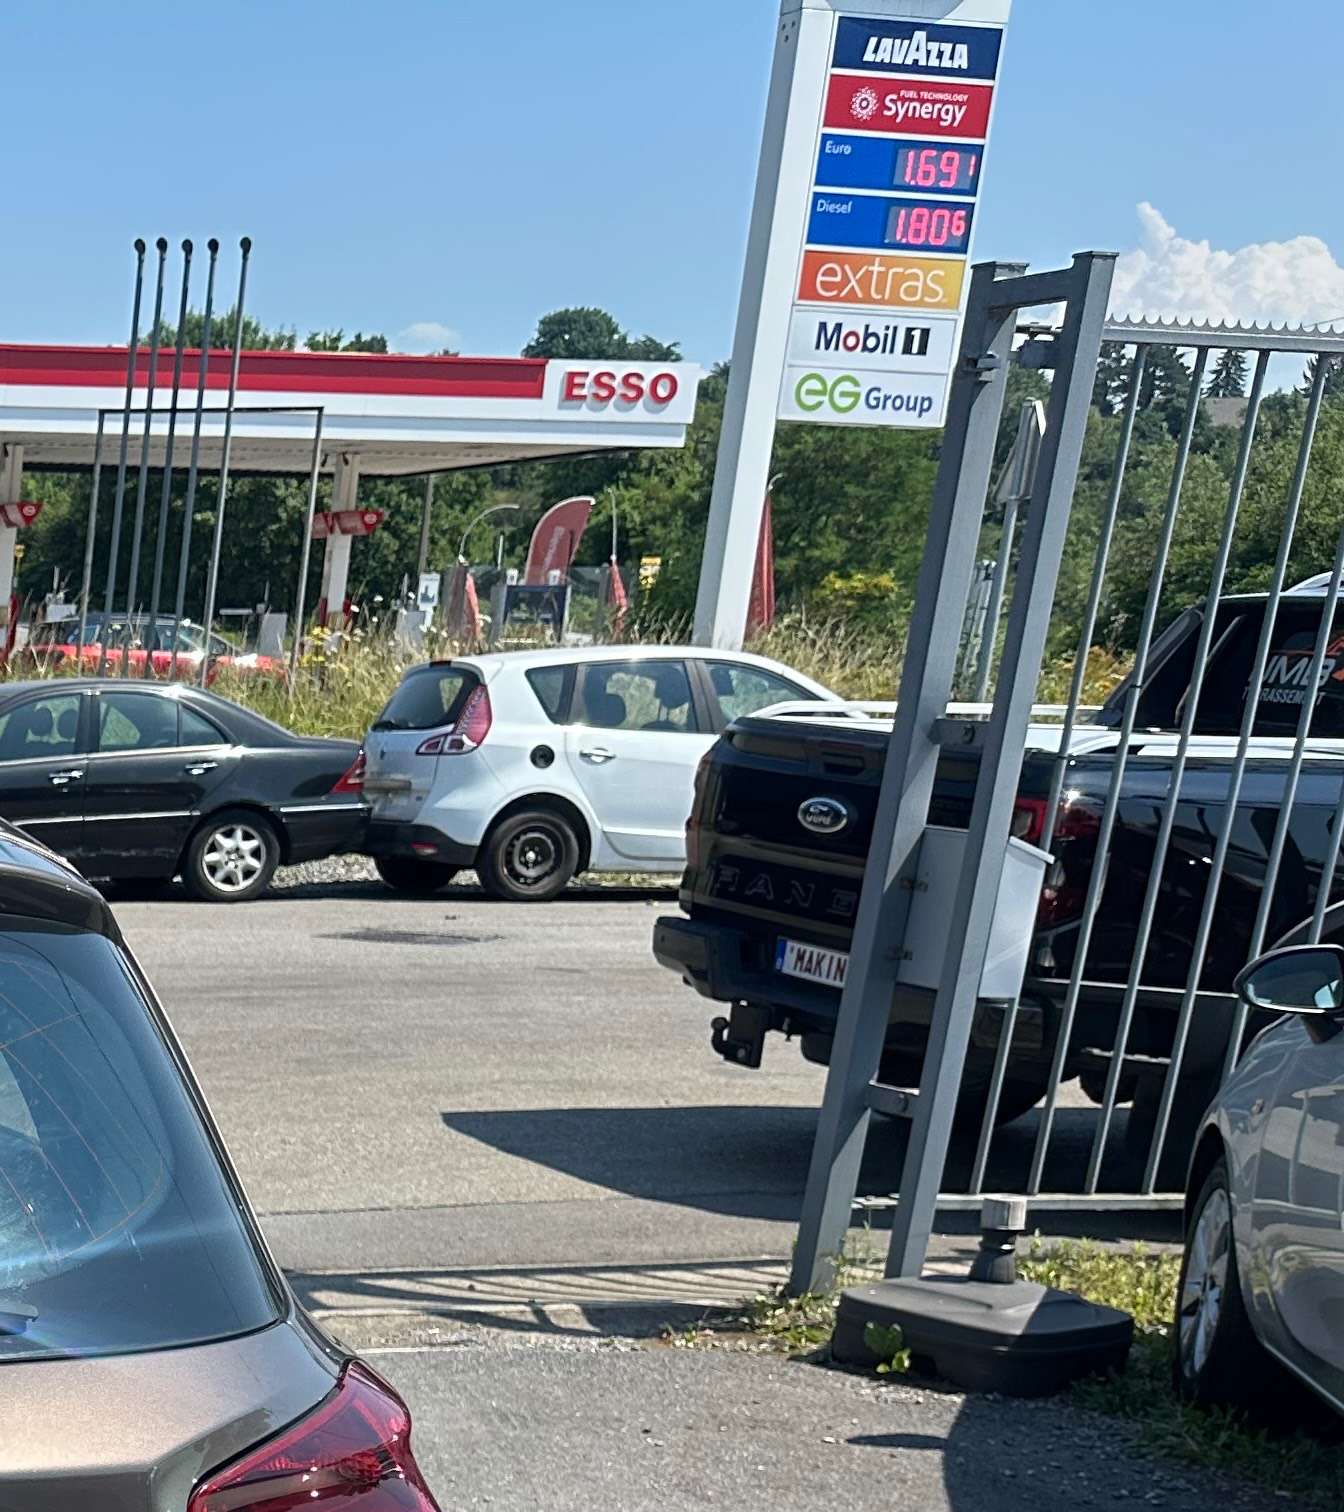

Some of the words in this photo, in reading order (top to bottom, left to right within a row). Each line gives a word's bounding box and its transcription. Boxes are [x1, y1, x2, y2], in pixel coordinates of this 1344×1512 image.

[862, 30, 969, 69] LAVAZZA
[883, 94, 968, 127] Synergy
[899, 89, 918, 99] FUEL
[919, 91, 969, 102] TECHNOLOGY
[825, 140, 852, 155] Euro
[816, 198, 853, 214] Diesel
[815, 257, 945, 303] extras
[814, 321, 898, 354] Mobil
[564, 371, 679, 405] ESSO
[864, 386, 933, 418] Group
